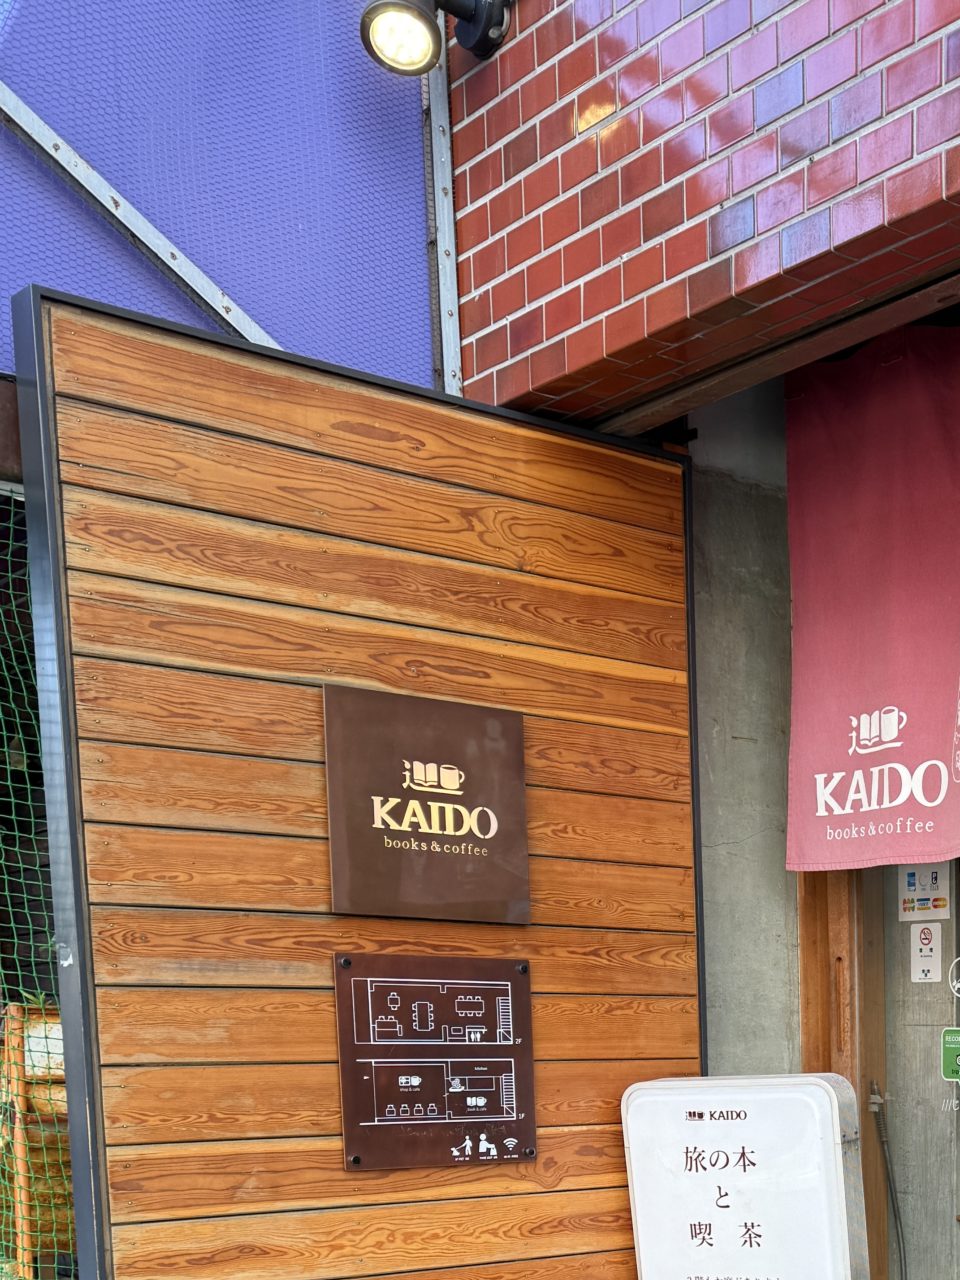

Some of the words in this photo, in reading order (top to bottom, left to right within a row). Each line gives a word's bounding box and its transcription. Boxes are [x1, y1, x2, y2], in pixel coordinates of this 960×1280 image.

[814, 759, 949, 817] KAIDO
[371, 795, 499, 839] KAIDO
[709, 1110, 748, 1121] KAIDO
[683, 1146, 757, 1173] 旅の本
[715, 1185, 731, 1209] と
